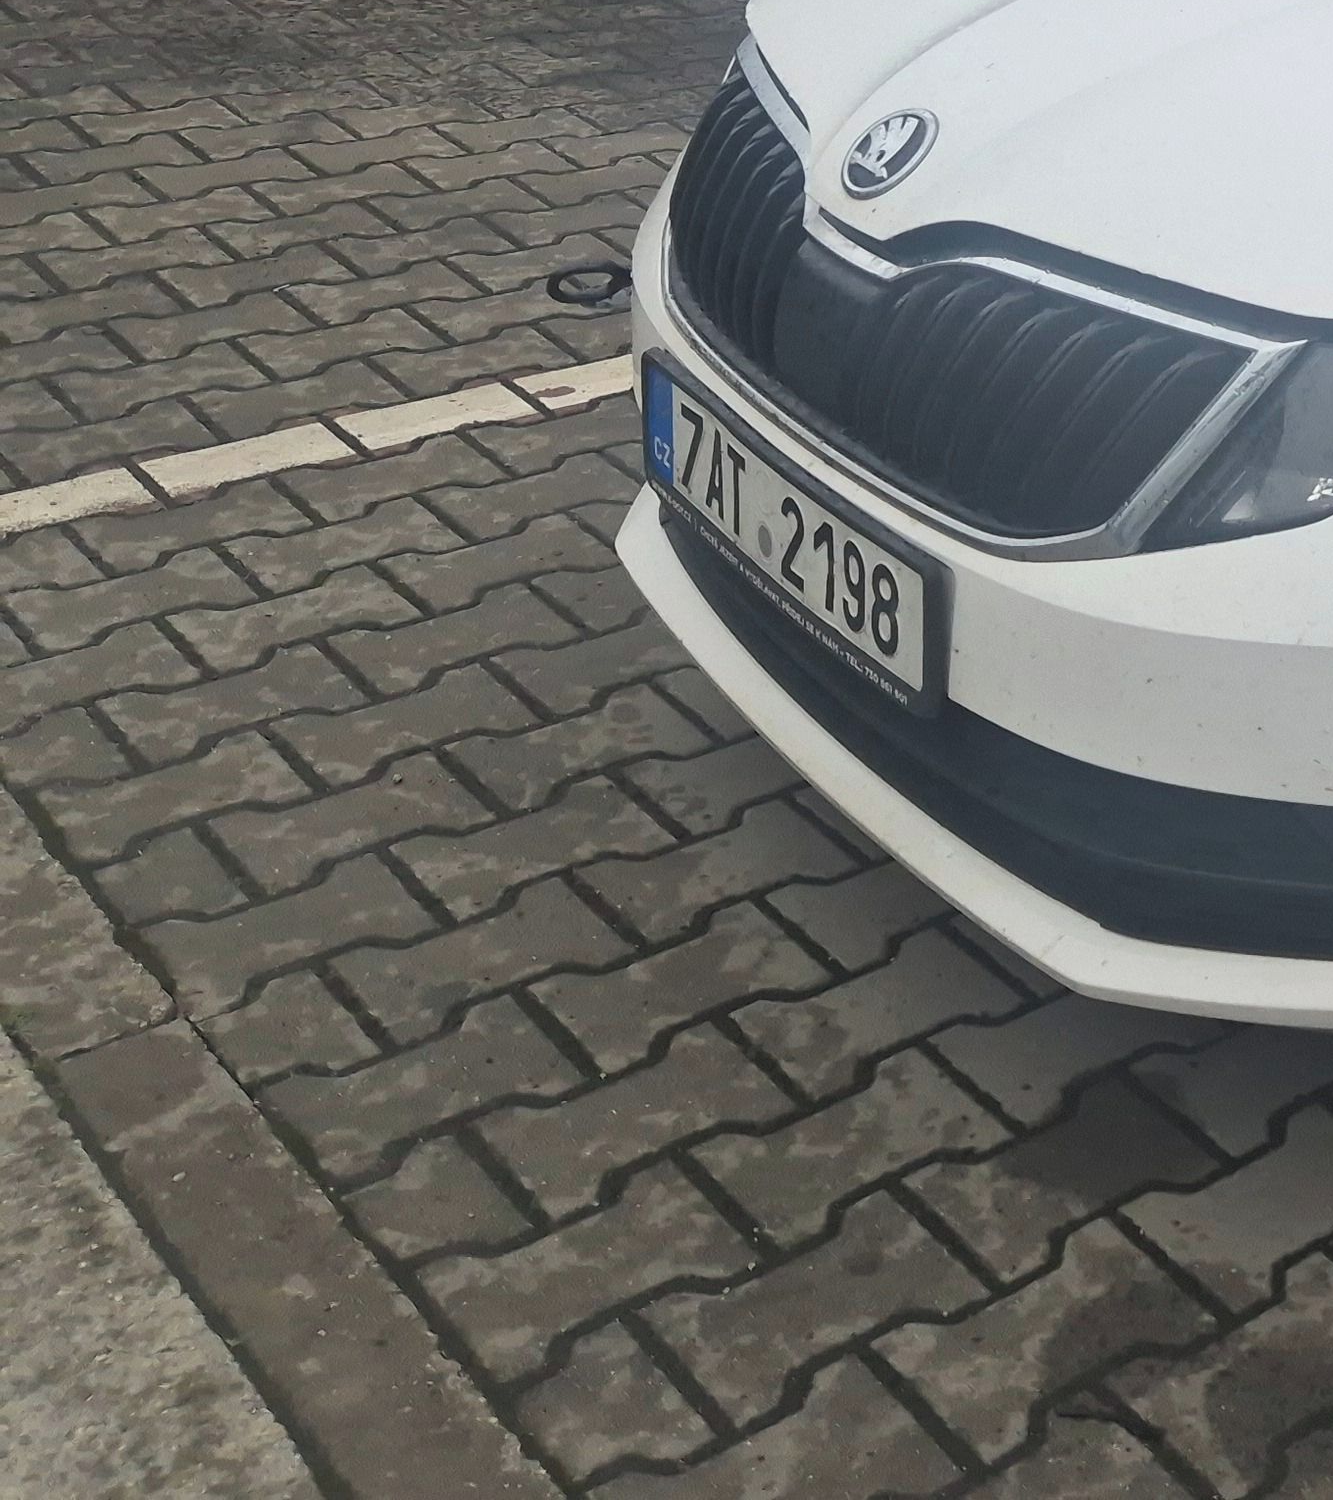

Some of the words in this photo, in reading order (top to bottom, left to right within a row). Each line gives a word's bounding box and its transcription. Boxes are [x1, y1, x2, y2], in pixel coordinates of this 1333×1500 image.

[654, 436, 672, 468] CZ
[680, 402, 746, 537] 7AT
[781, 496, 900, 658] 2198
